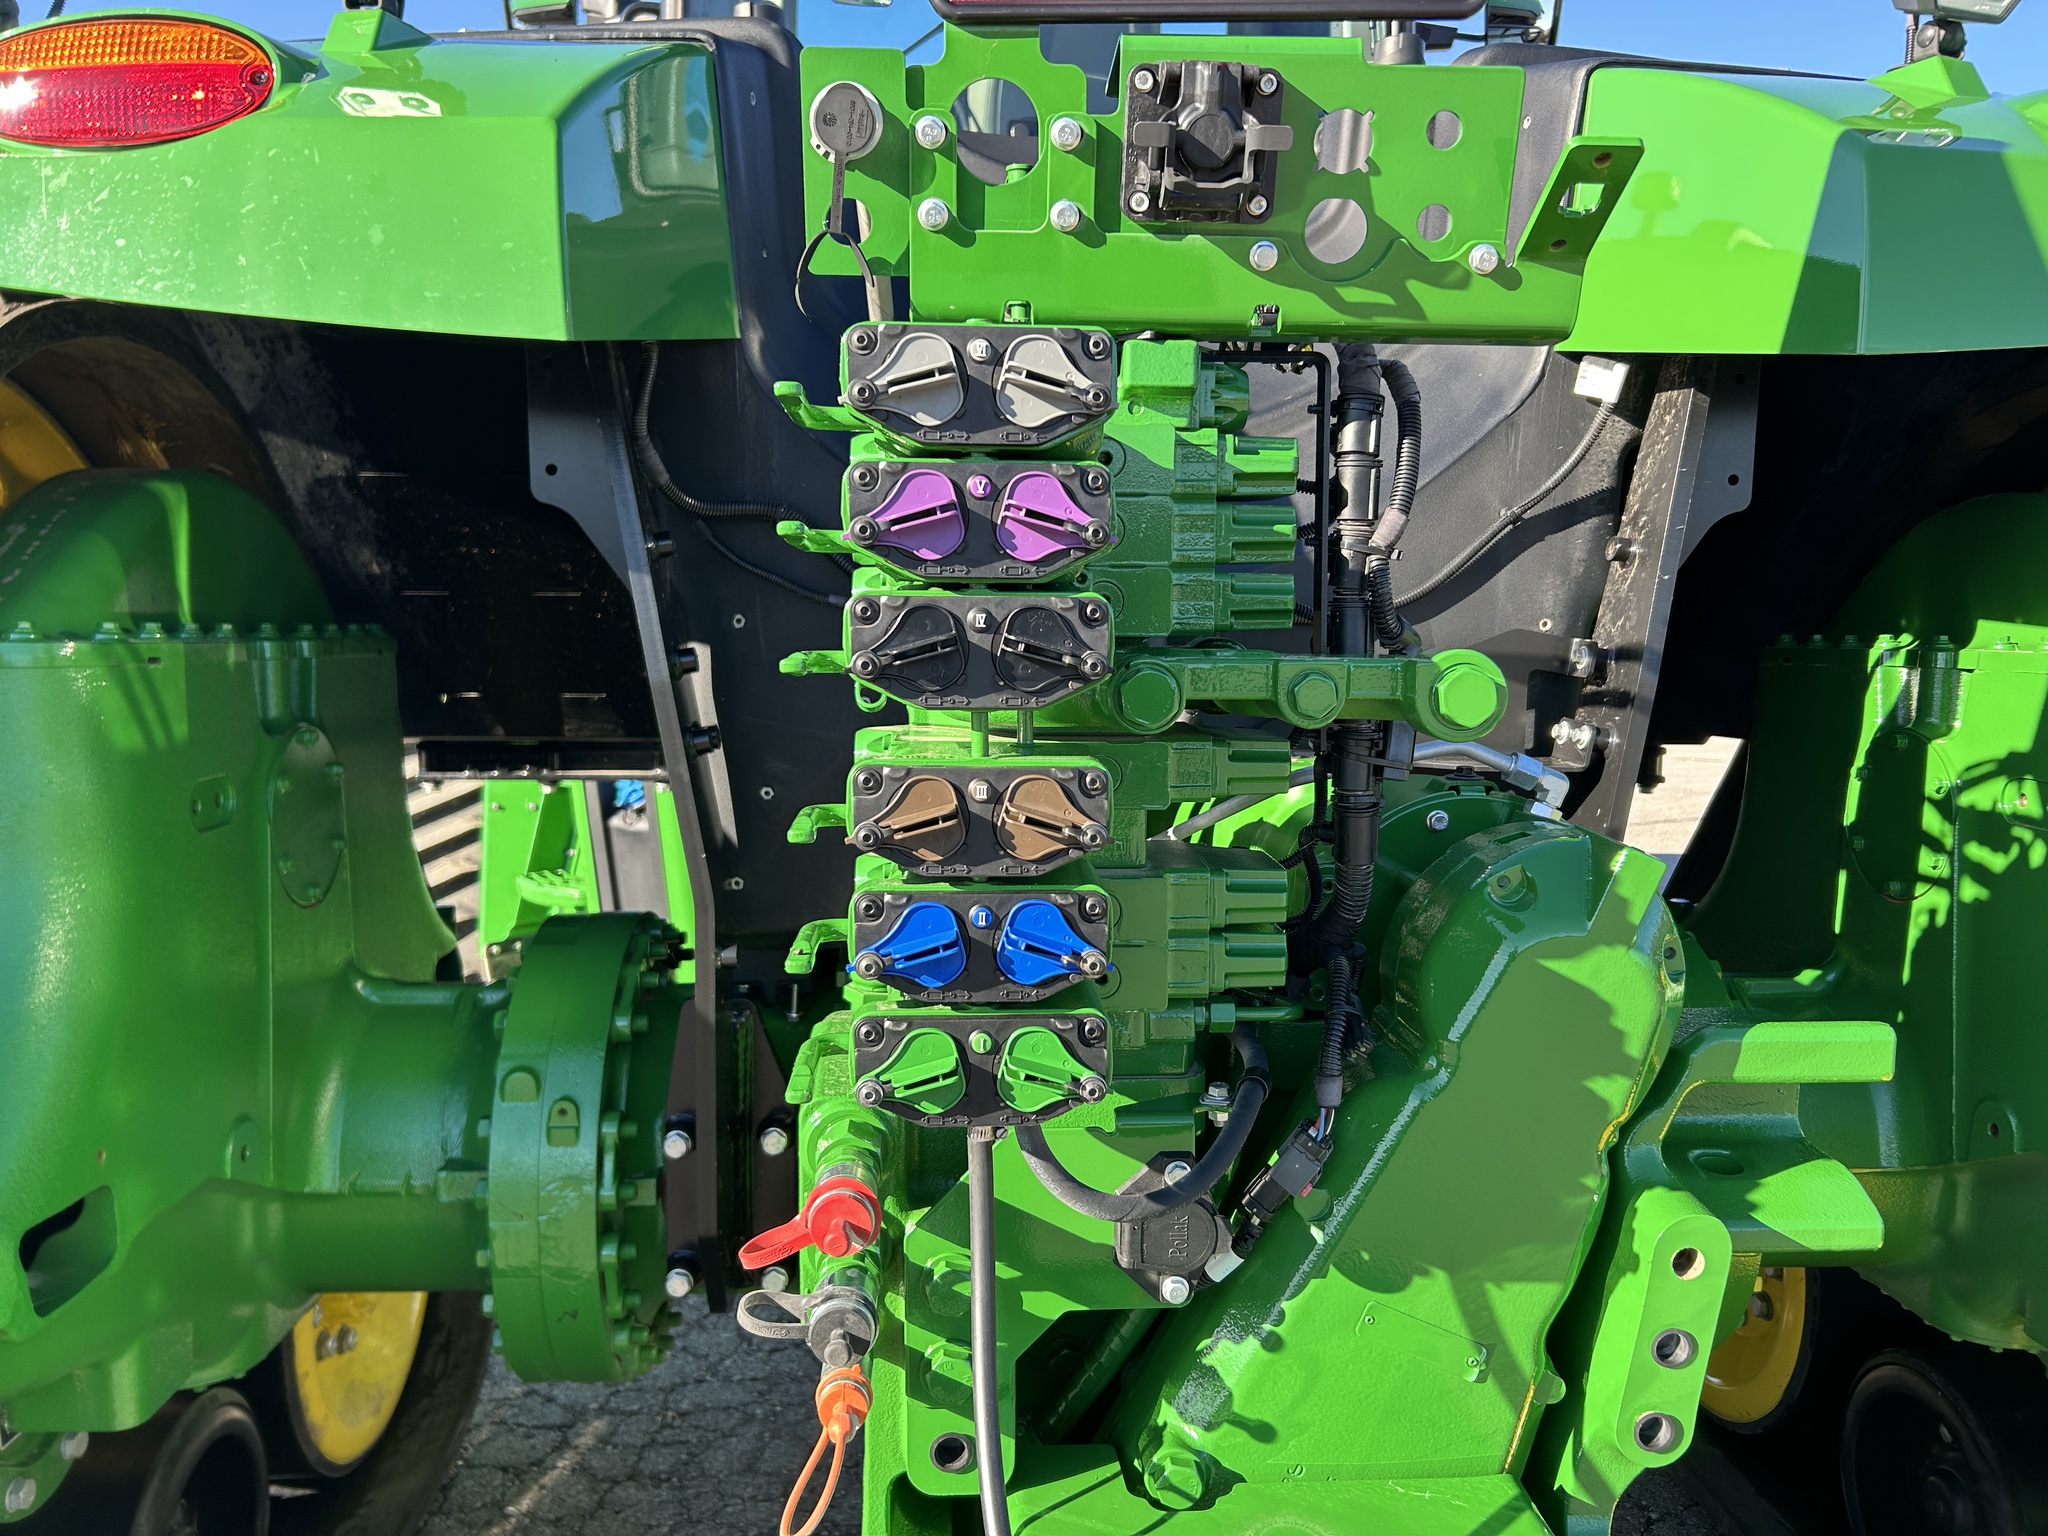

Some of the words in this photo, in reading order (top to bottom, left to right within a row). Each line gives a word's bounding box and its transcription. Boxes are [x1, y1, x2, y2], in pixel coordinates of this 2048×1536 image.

[975, 341, 987, 357] VI
[975, 479, 987, 494] V
[975, 613, 987, 628] IV
[976, 785, 988, 799] III
[978, 911, 987, 926] II
[979, 1038, 985, 1052] I
[1028, 1157, 1062, 1196] Exceeds
[1168, 1215, 1189, 1259] Pollak
